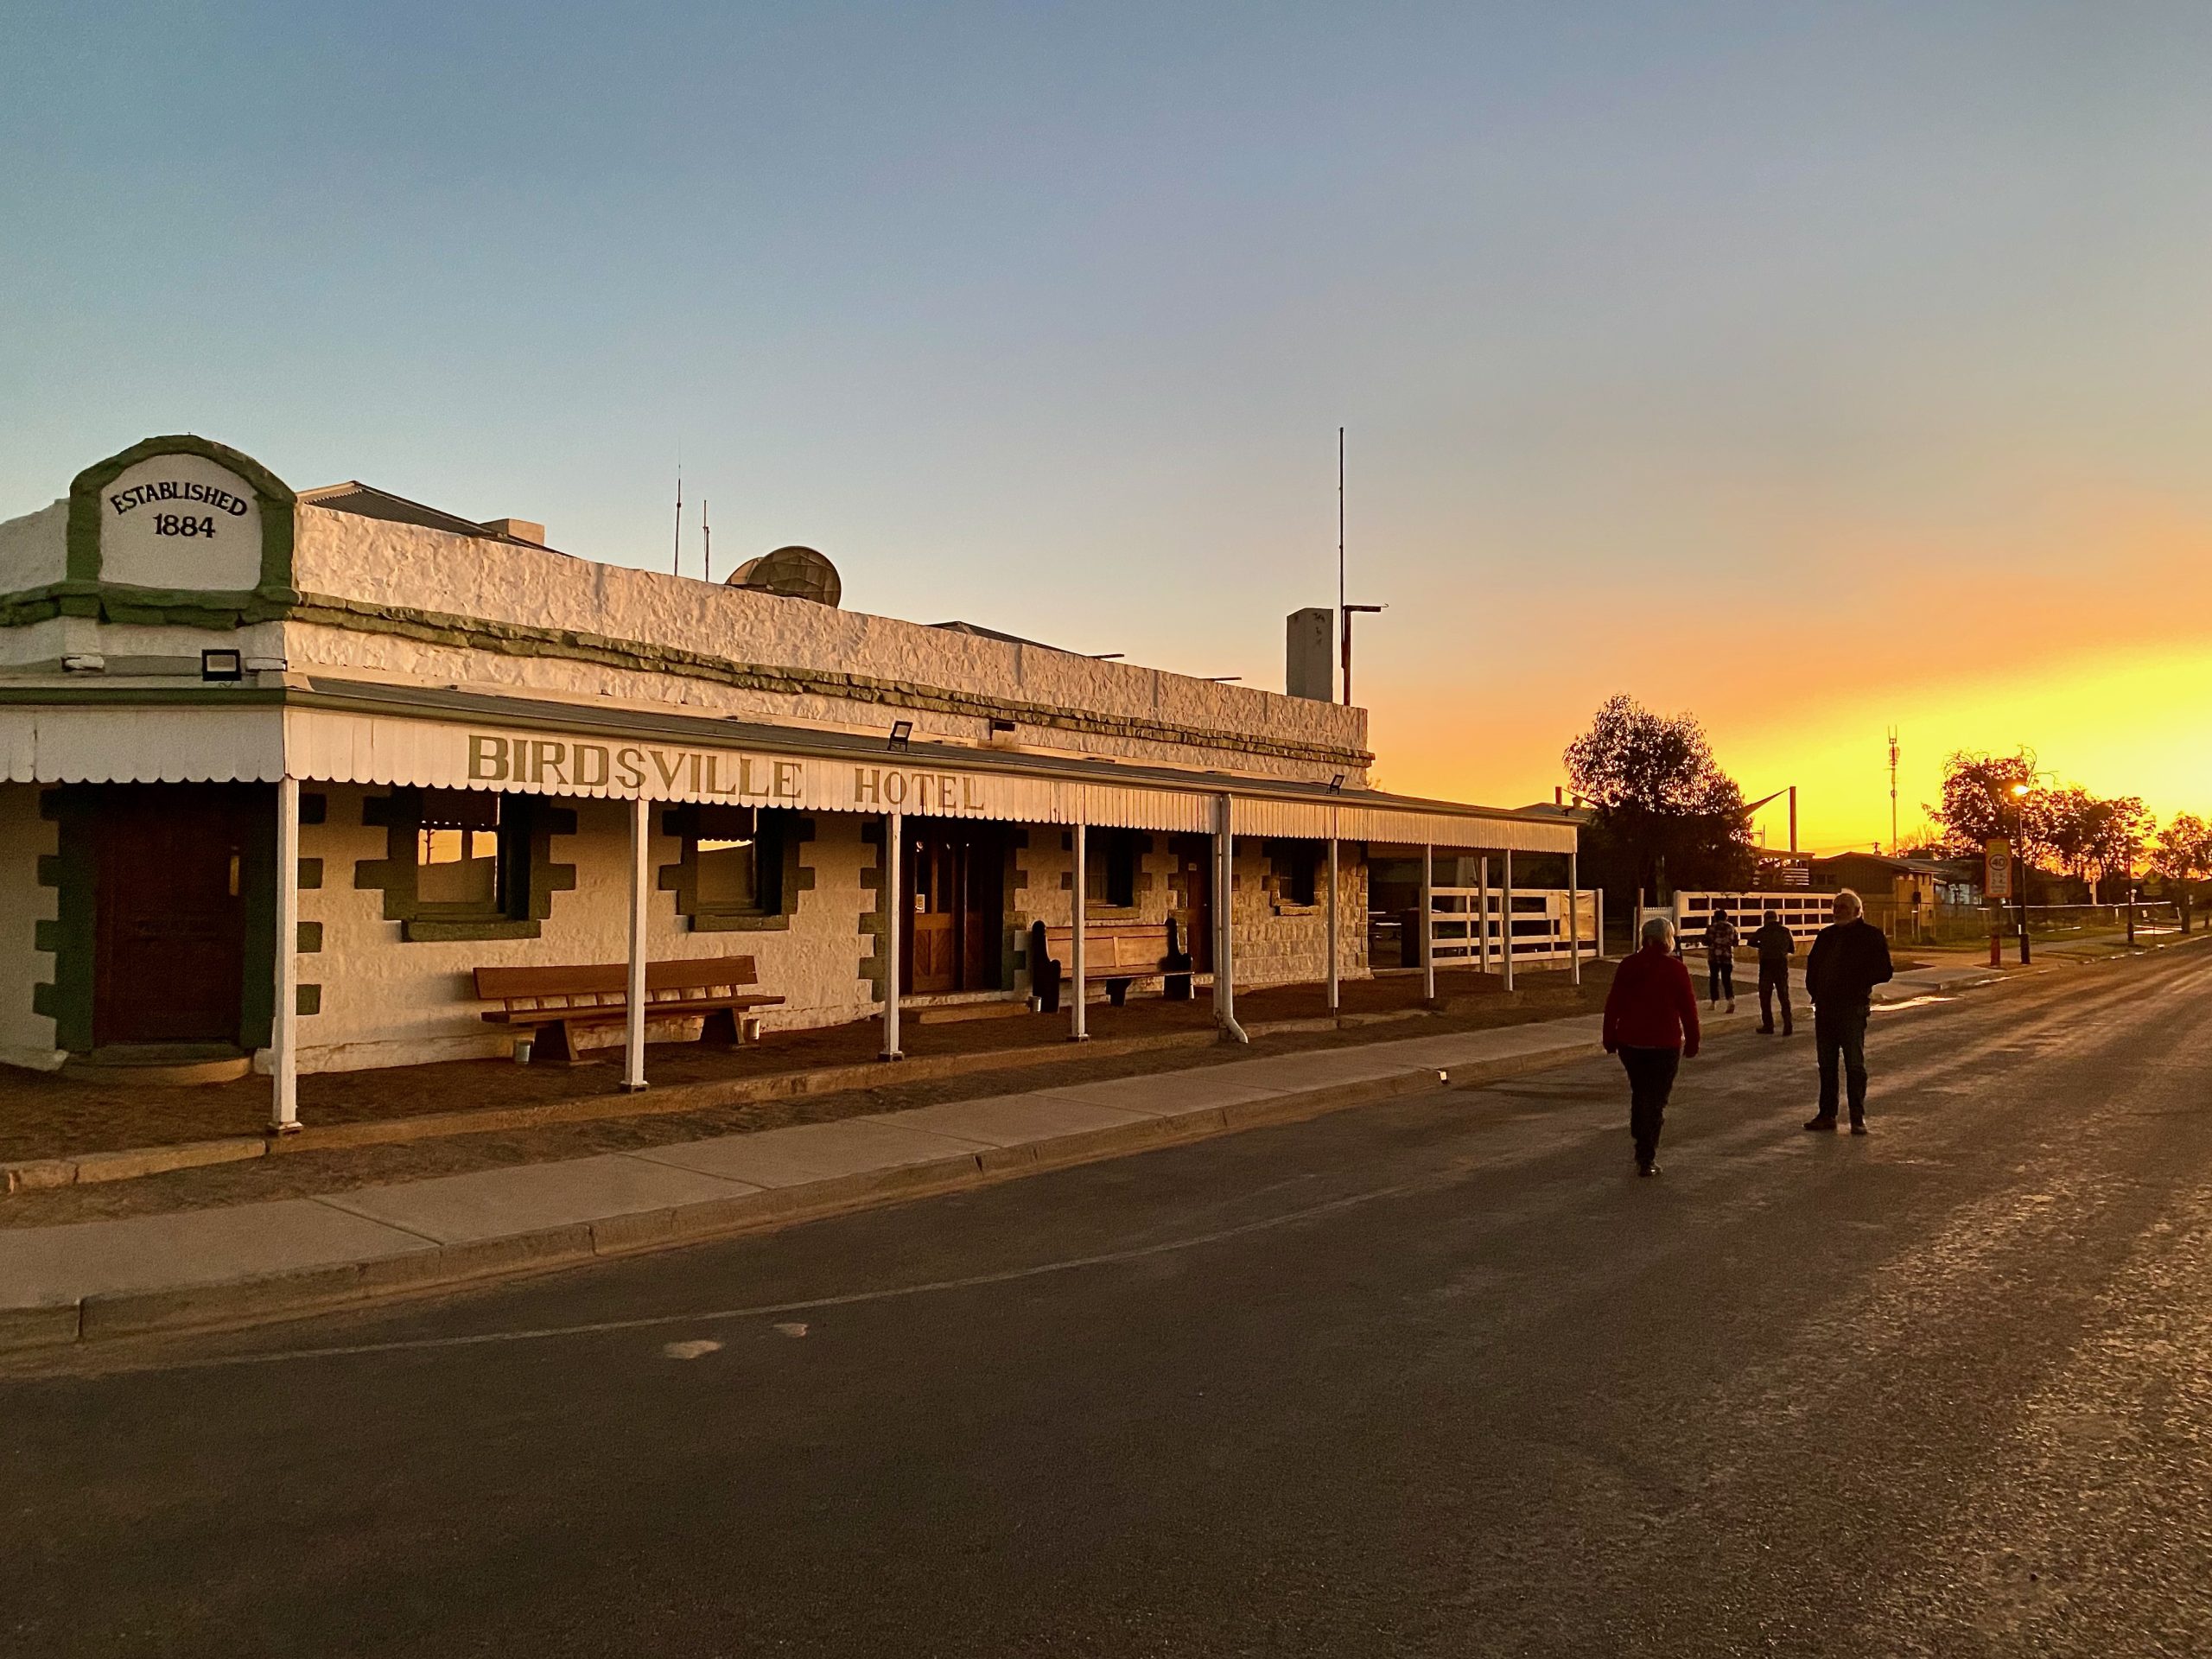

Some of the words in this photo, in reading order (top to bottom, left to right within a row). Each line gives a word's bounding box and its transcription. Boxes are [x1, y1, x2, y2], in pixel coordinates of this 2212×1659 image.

[110, 481, 248, 517] ESTABLISHED
[152, 513, 216, 538] 1884
[467, 734, 802, 799] BIRDSVILLE
[854, 767, 984, 810] HOTEL
[1992, 857, 2005, 867] 40
